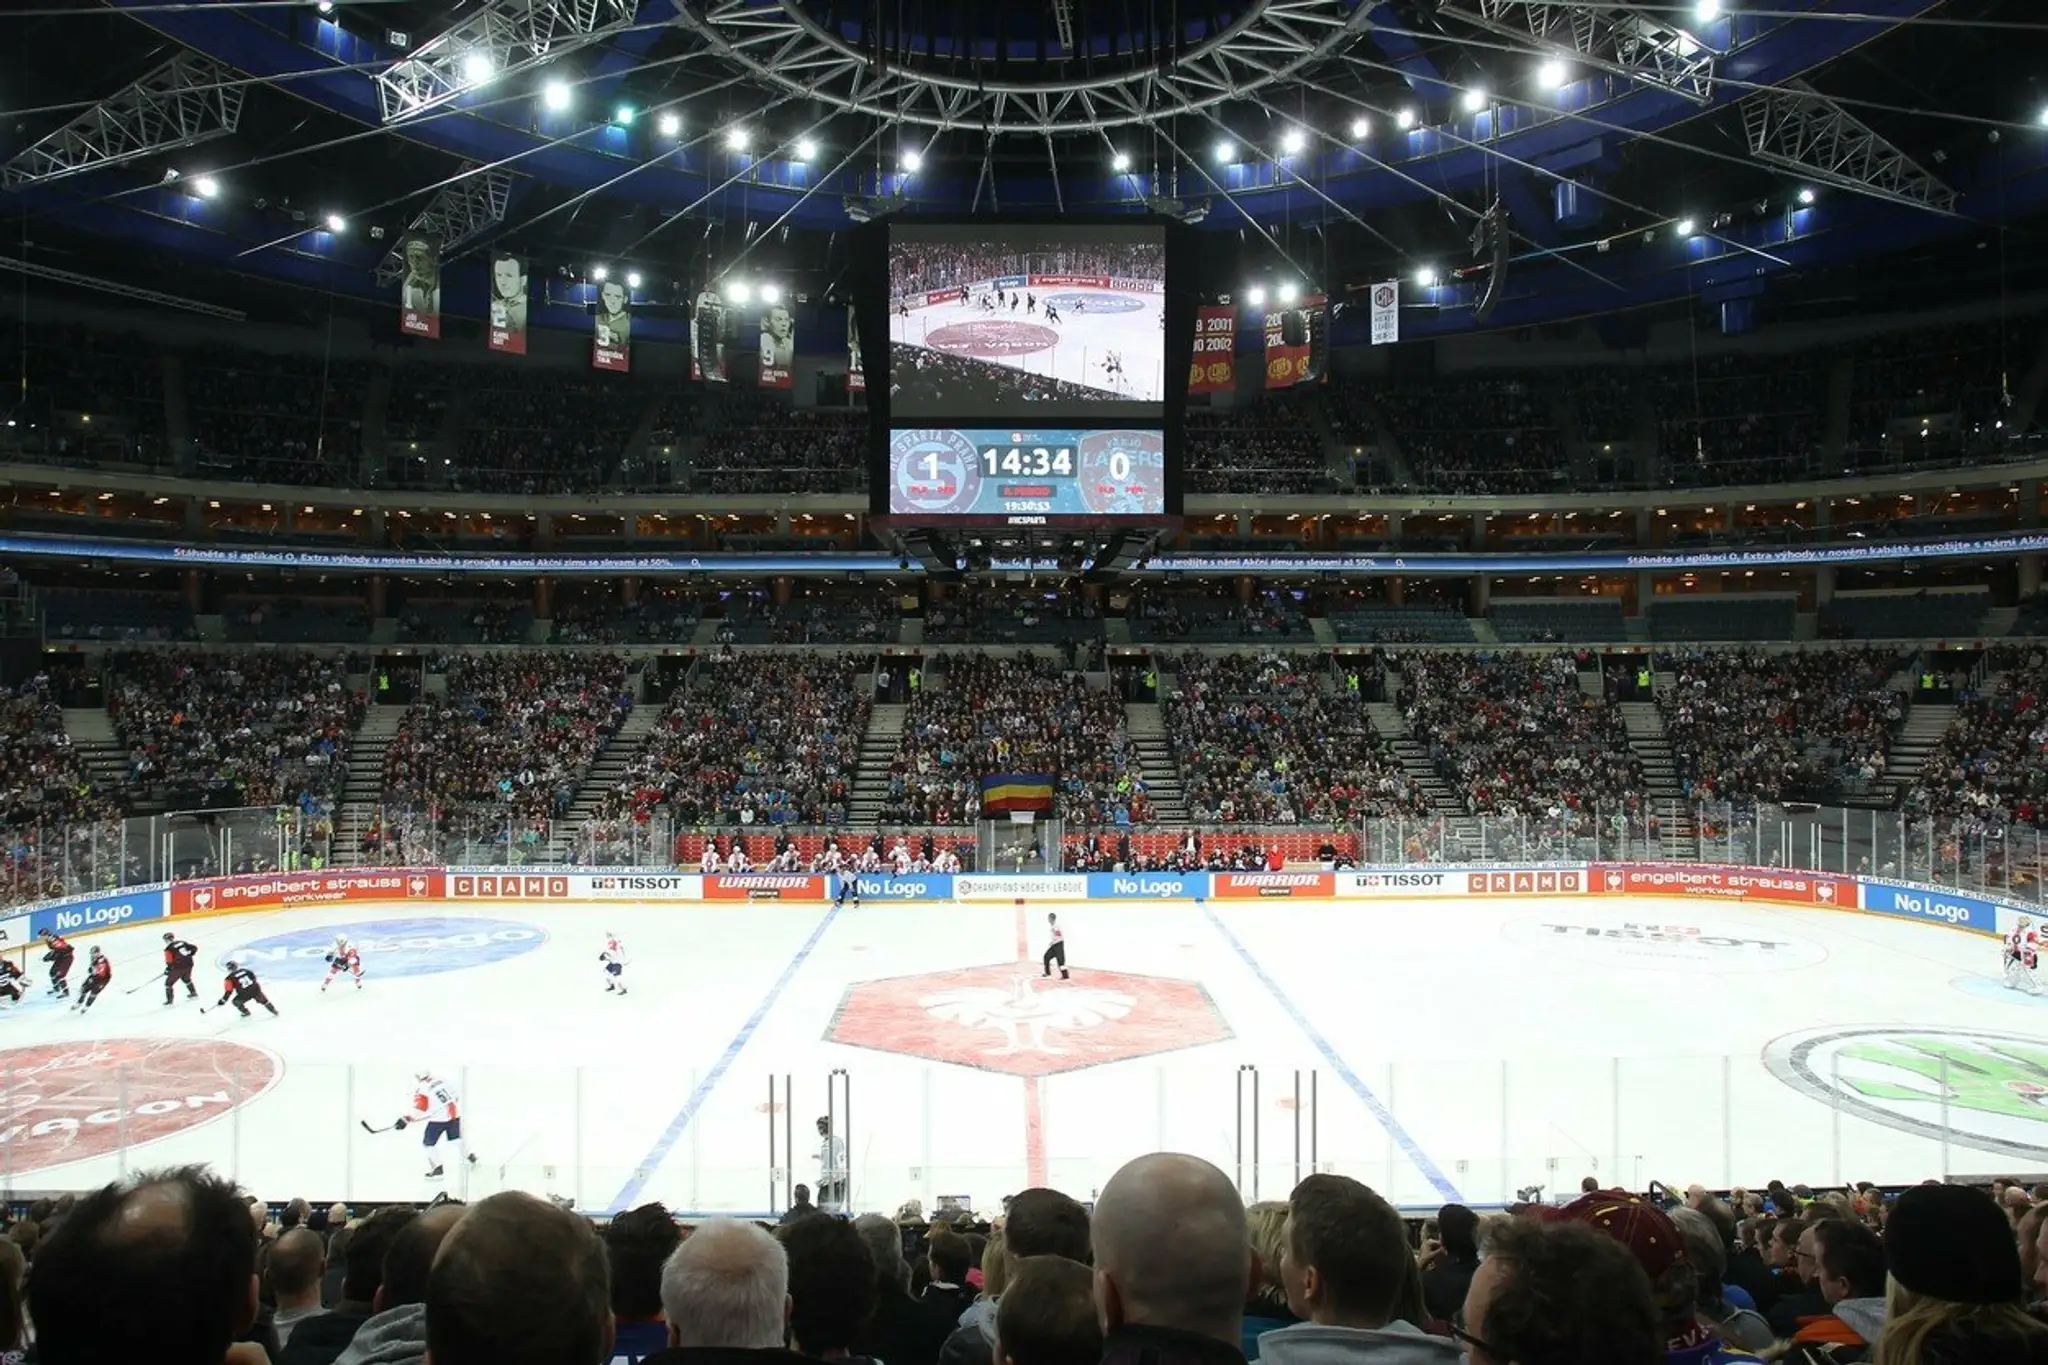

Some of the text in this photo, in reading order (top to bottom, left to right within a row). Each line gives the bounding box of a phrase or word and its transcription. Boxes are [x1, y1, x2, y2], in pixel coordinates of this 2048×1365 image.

[1208, 318, 1232, 332] 2001
[1206, 338, 1232, 352] 2002
[897, 430, 943, 453] SPARTA
[947, 434, 978, 471] PRAHA
[923, 452, 938, 480] 1
[983, 448, 1072, 476] 14:34
[1083, 450, 1163, 469] LAERS
[1109, 451, 1130, 480] 0
[222, 877, 402, 898] engelbert strauss
[458, 879, 564, 893] CRAMO
[617, 877, 682, 889] TISSOT
[718, 876, 810, 888] WARRIOR
[973, 882, 1083, 893] CHAMPIONS HOCKEY LEAGUE
[1230, 874, 1319, 887] WARRIOR
[1381, 874, 1445, 886] TISSOT
[1473, 876, 1576, 888] CRAMO
[1631, 872, 1807, 891] engelbert strauss
[857, 880, 926, 897] No Logo
[1114, 879, 1183, 897] No Logo
[1685, 885, 1748, 896] workwear
[282, 890, 347, 903] workwear
[1895, 892, 1970, 923] No Logo
[56, 903, 133, 930] No Logo
